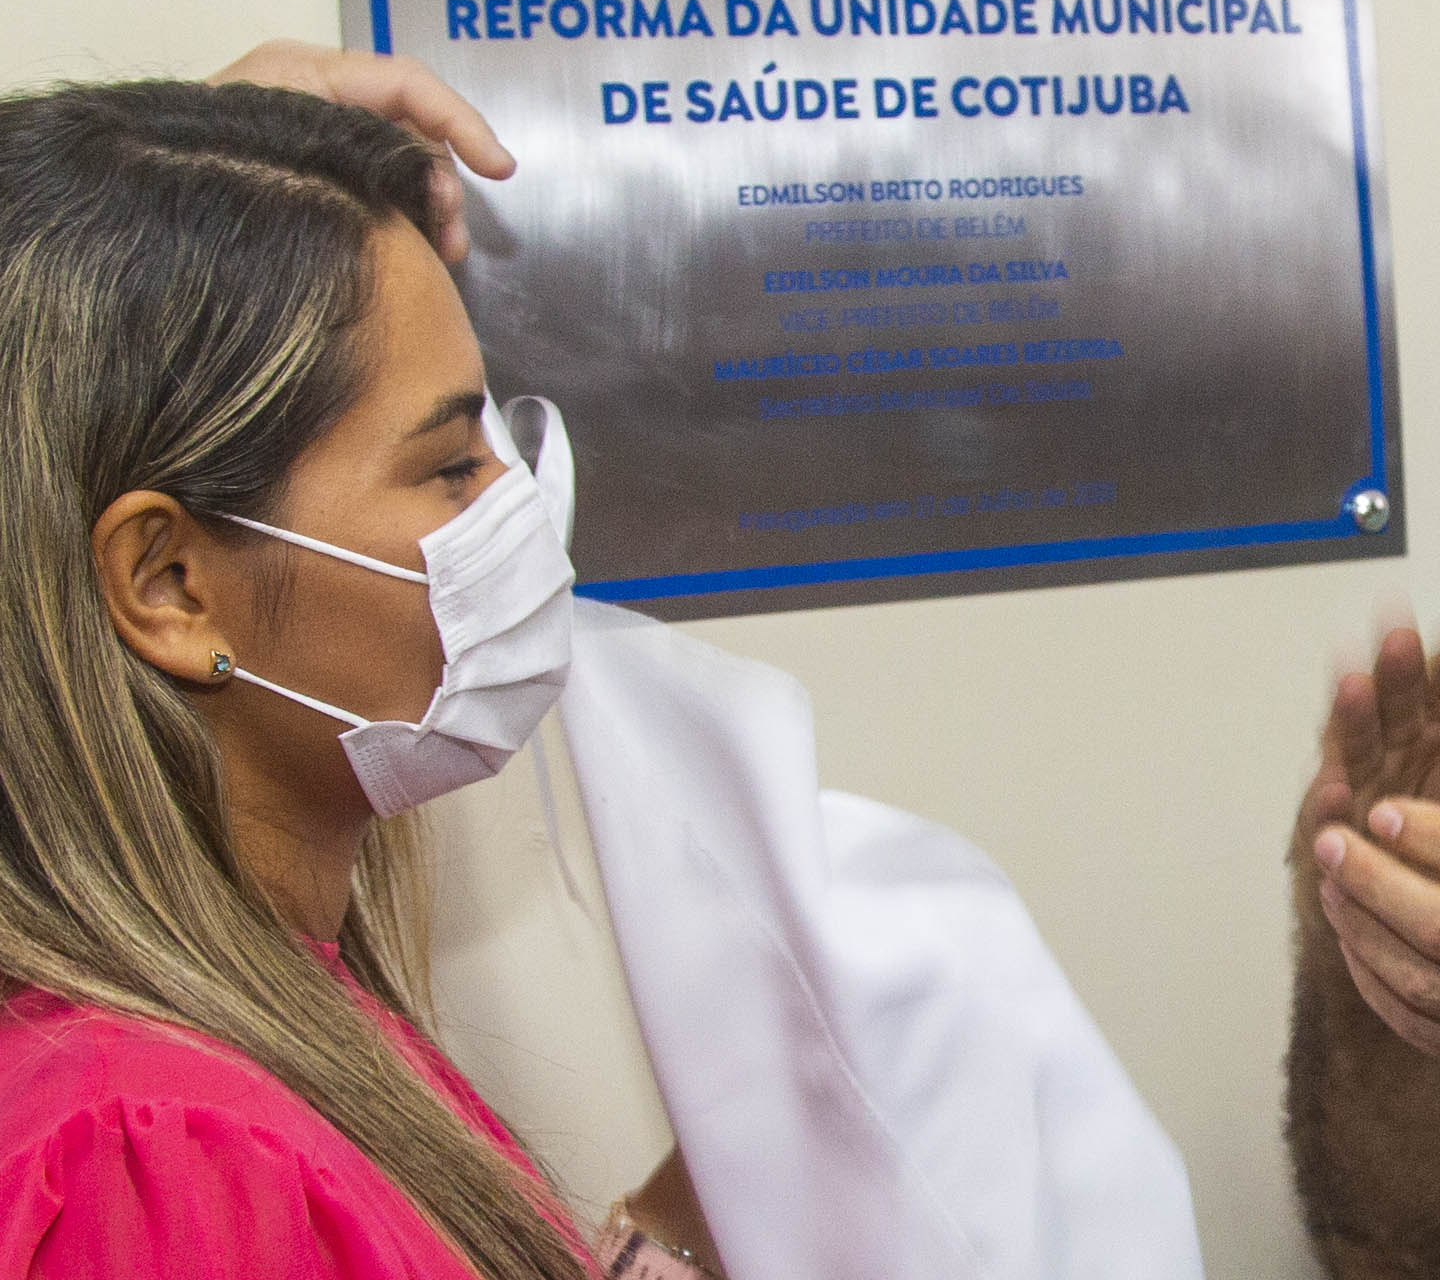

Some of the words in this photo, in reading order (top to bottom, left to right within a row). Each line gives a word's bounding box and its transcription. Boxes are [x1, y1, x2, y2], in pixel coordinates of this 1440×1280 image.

[601, 80, 673, 125] DE
[685, 60, 860, 123] SAÚDE
[873, 76, 939, 119] DE
[949, 72, 1191, 118] COTIJUBA
[737, 182, 865, 206] EDMILSON
[870, 179, 942, 202] BRITO
[948, 174, 1085, 200] RODRIGUES
[968, 262, 1002, 285] DA
